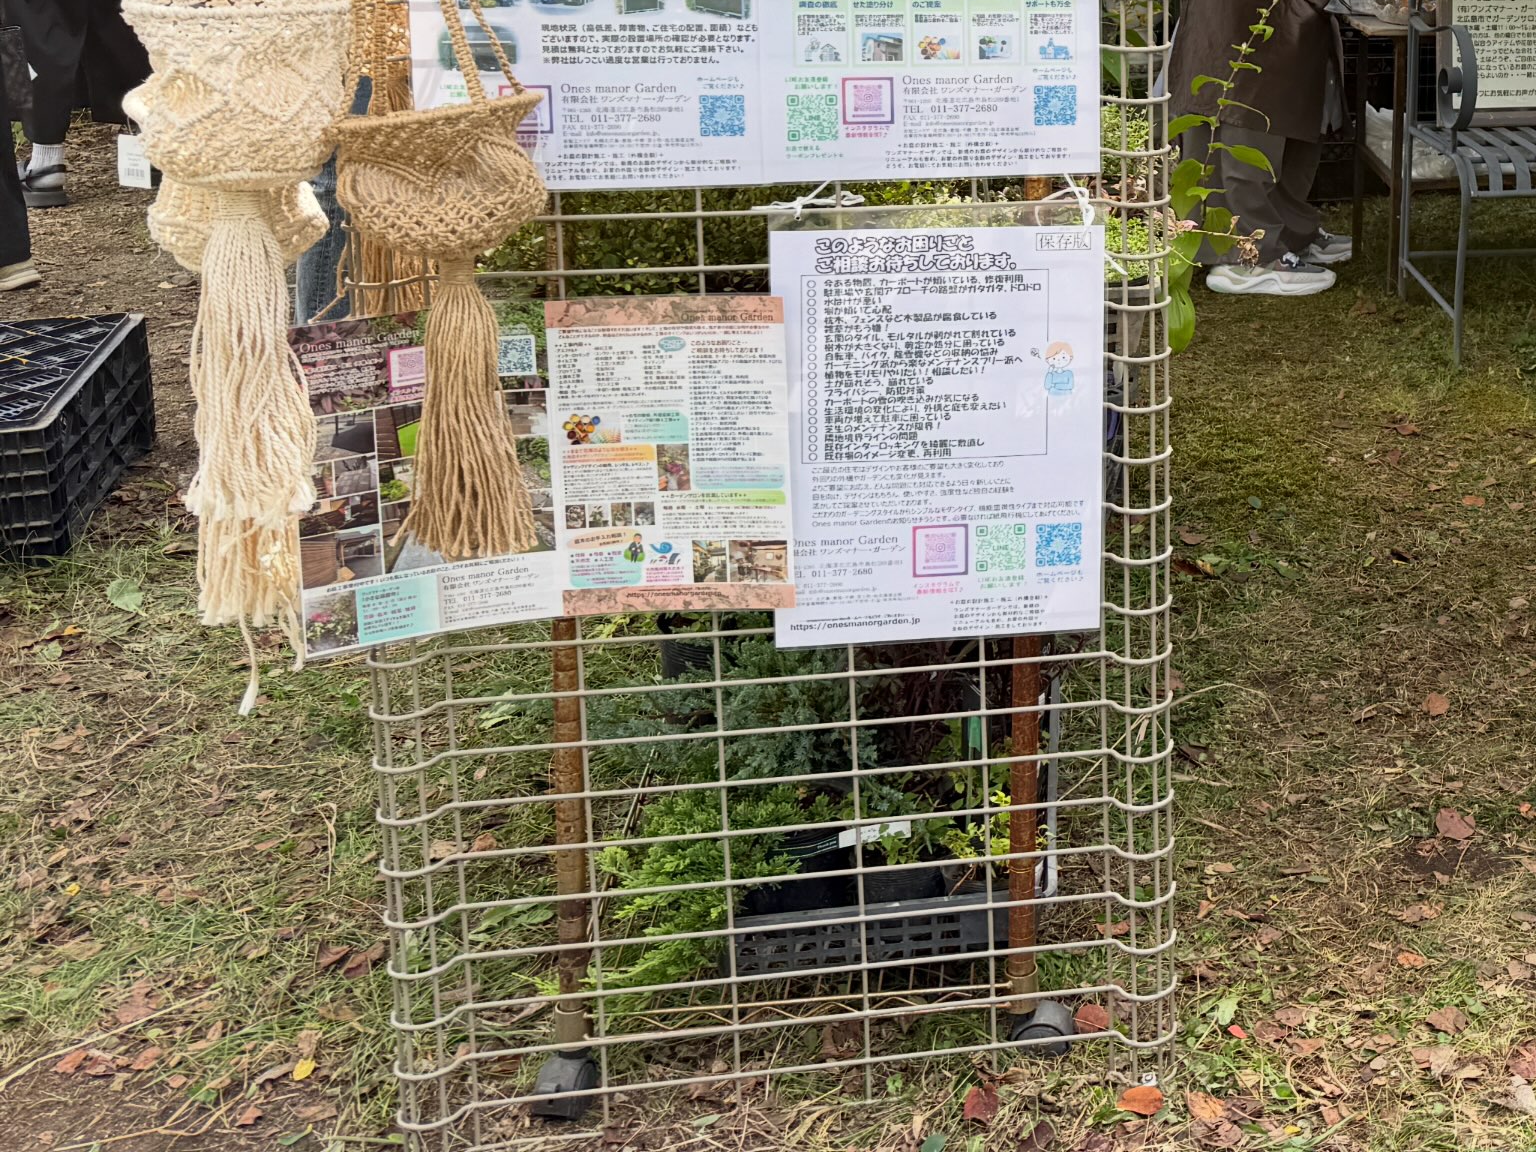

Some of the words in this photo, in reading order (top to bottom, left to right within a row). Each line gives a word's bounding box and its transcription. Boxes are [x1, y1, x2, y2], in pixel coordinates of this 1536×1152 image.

[1025, 0, 1072, 8] サポートも万全
[541, 34, 756, 43] ございますので、実際の設置場所の確認が必要となります。
[542, 45, 745, 54] 見積は無料となっておりますのでお気軽にご連絡下さい。
[902, 75, 931, 85] Ones
[935, 77, 969, 85] manor
[973, 75, 1013, 85] Garden
[560, 83, 591, 94] Ones
[595, 85, 631, 94] manor
[634, 83, 677, 94] Garden
[903, 86, 938, 95] 有限会社
[561, 96, 598, 104] 有限会社
[903, 105, 923, 113] TEL
[931, 104, 998, 113] 011-377-2680
[562, 114, 583, 123] TEL
[591, 114, 661, 123] 011-377-2680
[815, 235, 974, 254] このようなお困りごと
[1039, 233, 1089, 250] 保存版
[815, 252, 1017, 274] ご相談お待ちしております。
[824, 297, 882, 307] 水はけが悪い
[708, 314, 737, 322] manor
[740, 312, 774, 321] Garden
[300, 341, 332, 354] Ones
[335, 337, 374, 349] manor
[377, 328, 420, 343] Garden
[820, 538, 854, 546] manor
[858, 535, 898, 545] Garden
[442, 573, 465, 584] Ones
[468, 570, 495, 580] manor
[497, 566, 529, 577] Garden
[811, 568, 873, 578] 011-377-2680
[791, 617, 920, 632] https://onesmanorgarden.jp
